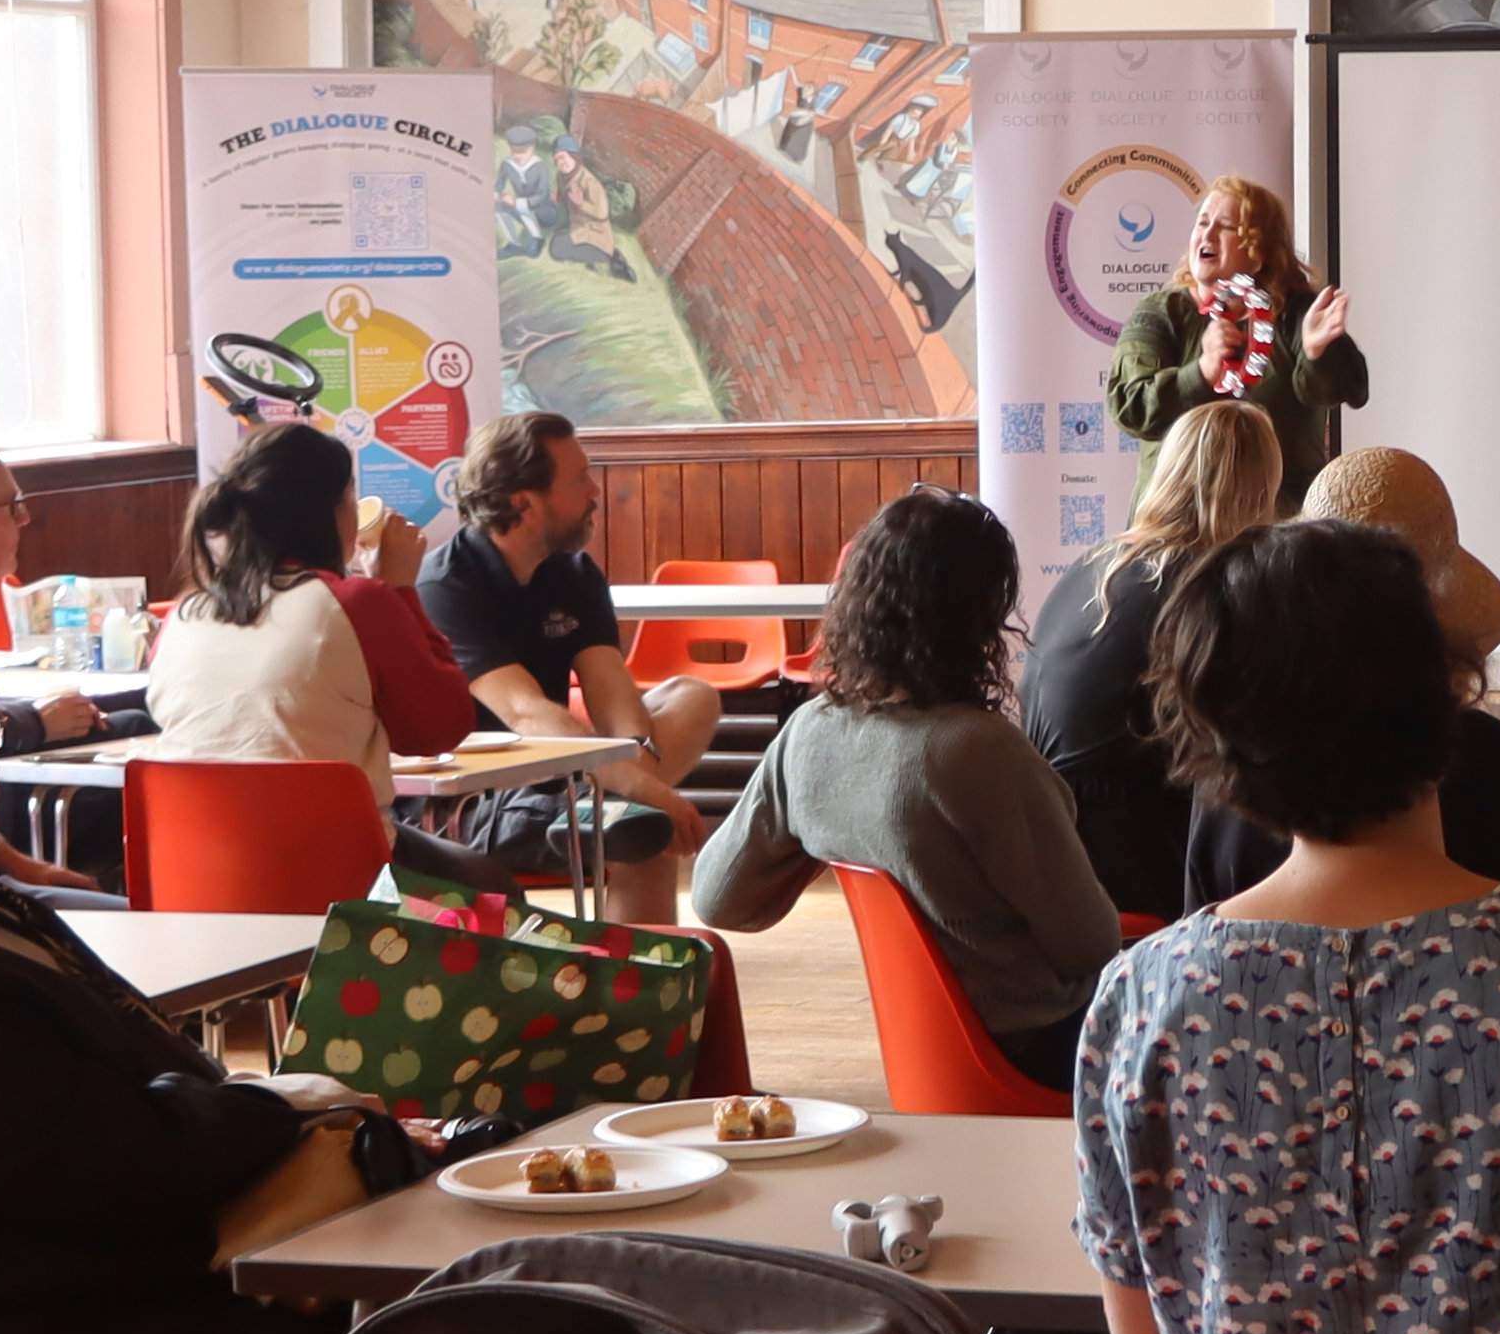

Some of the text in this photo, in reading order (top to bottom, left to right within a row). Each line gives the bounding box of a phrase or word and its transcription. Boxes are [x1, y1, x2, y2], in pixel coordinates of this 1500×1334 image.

[995, 91, 1076, 104] DIALOGUE
[1091, 90, 1173, 103] DIALOGUE
[1188, 89, 1270, 102] DIALOGUE
[1002, 114, 1070, 127] SOCIETY
[1099, 113, 1166, 125] SOCIETY
[1196, 112, 1263, 125] SOCIETY
[220, 114, 473, 157] THE DIALOGUE CIRCLE
[1067, 150, 1202, 196] Connecting Communities
[1052, 210, 1119, 339] mpowering Engagement
[1102, 263, 1170, 275] DIALOGUE
[1108, 282, 1165, 293] SOCIETY
[307, 348, 347, 357] FRIENDS
[358, 347, 389, 355] ALLIES
[401, 404, 449, 413] PARTNERS
[1060, 473, 1098, 484] Donate:
